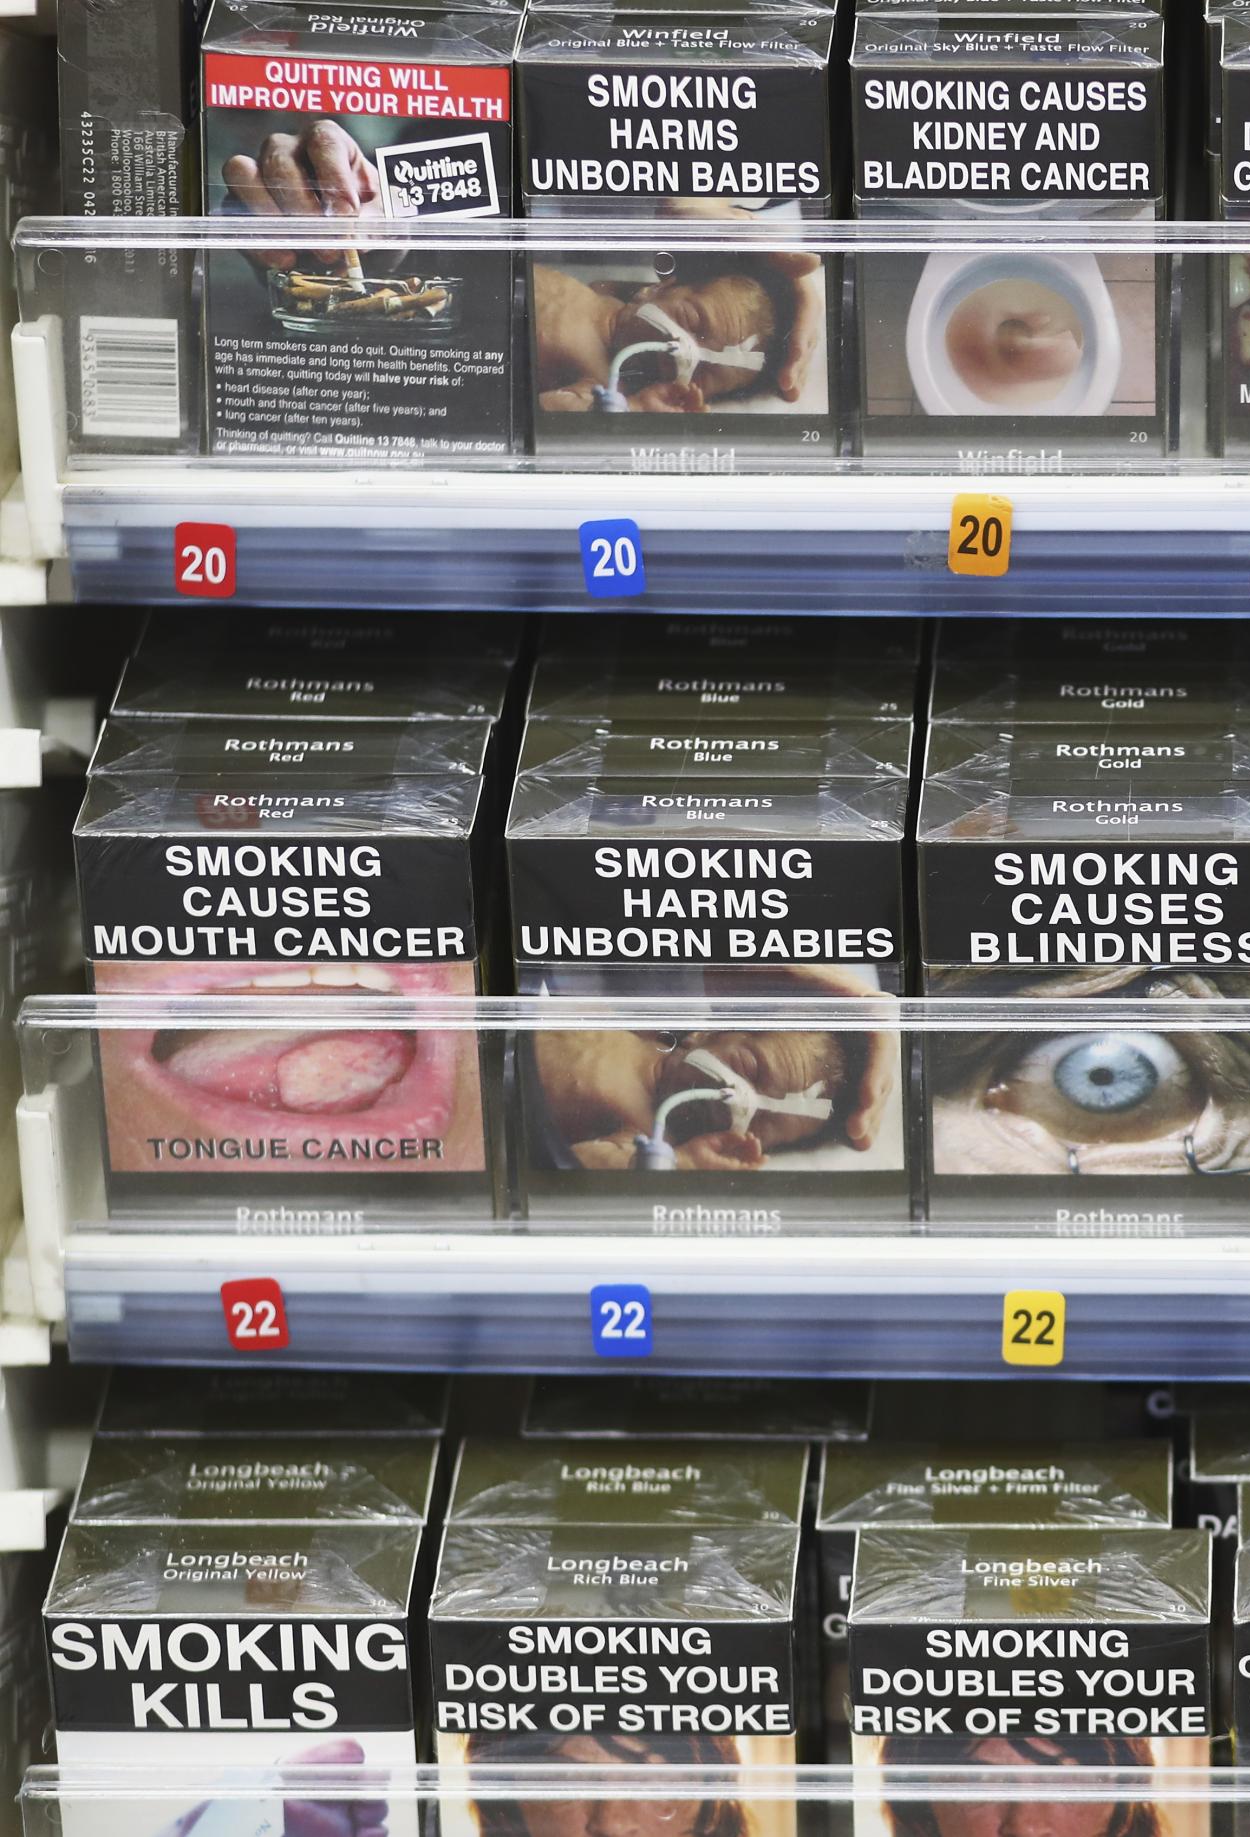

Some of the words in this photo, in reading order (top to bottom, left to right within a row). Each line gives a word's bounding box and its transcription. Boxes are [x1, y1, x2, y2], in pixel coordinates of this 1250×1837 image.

[312, 19, 422, 37] Winfield
[350, 17, 425, 30] Original
[623, 29, 728, 41] Winfield
[548, 38, 610, 48] Original
[617, 39, 649, 47] Blue
[720, 40, 755, 48] Flow
[761, 41, 801, 50] Filter
[266, 62, 380, 87] QUITTING
[389, 68, 448, 90] WILL
[212, 84, 322, 110] IMPROVE
[330, 91, 398, 114] YOUR
[408, 95, 502, 118] HEALTH
[588, 74, 756, 109] SMOKING
[865, 80, 1009, 110] SMOKING
[1020, 81, 1146, 111] CAUSES
[111, 129, 120, 164] Phone:
[156, 131, 166, 163] British
[611, 119, 738, 151] HARMS
[914, 122, 1027, 150] KIDNEY
[1035, 123, 1099, 150] AND
[168, 131, 178, 202] Manufactured
[394, 157, 477, 184] Quitline
[532, 159, 678, 191] UNBORN
[692, 162, 819, 193] BABIES
[864, 161, 1010, 189] BLADDER
[1021, 163, 1149, 191] CANCER
[112, 169, 122, 195] 1800
[398, 184, 424, 207] 13
[432, 179, 481, 205] 7848
[214, 337, 239, 349] Long
[242, 340, 263, 348] term
[266, 340, 307, 350] smokers
[310, 342, 328, 352] can
[330, 342, 348, 353] and
[351, 344, 363, 354] do
[390, 345, 426, 359] Quitting
[430, 348, 470, 360] smoking
[473, 350, 482, 359] at
[485, 351, 504, 361] any
[225, 382, 250, 392] heart
[252, 384, 289, 395] disease
[320, 388, 339, 397] one
[225, 410, 246, 422] lung
[248, 412, 281, 421] cancer
[312, 414, 327, 424] ten
[801, 431, 820, 442] 20
[957, 515, 1002, 557] 20
[182, 546, 226, 583] 20
[591, 537, 636, 576] 20
[214, 794, 344, 806] Rothmans
[259, 809, 294, 818] Red
[642, 795, 772, 807] Rothmans
[1053, 800, 1182, 814] Rothmans
[687, 810, 725, 819] Blue
[1096, 815, 1138, 824] Gold
[166, 846, 381, 876] SMOKING
[995, 853, 1237, 885] SMOKING
[183, 887, 370, 917] CAUSES
[1012, 893, 1223, 925] CAUSES
[94, 926, 256, 955] MOUTH
[274, 927, 465, 957] CANCER
[146, 1137, 288, 1160] TONGUE
[303, 1138, 441, 1162] CANCER
[232, 1301, 279, 1337] 22
[601, 1301, 645, 1338] 22
[1012, 1310, 1055, 1345] 22
[167, 1552, 307, 1569] Longbeach
[548, 1556, 688, 1574] Longbeach
[164, 1569, 237, 1582] Original
[246, 1569, 307, 1579] Yellow
[573, 1574, 613, 1584] Rich
[620, 1574, 658, 1584] Blue
[52, 1623, 406, 1671] SMOKING
[132, 1683, 337, 1729] KILLS
